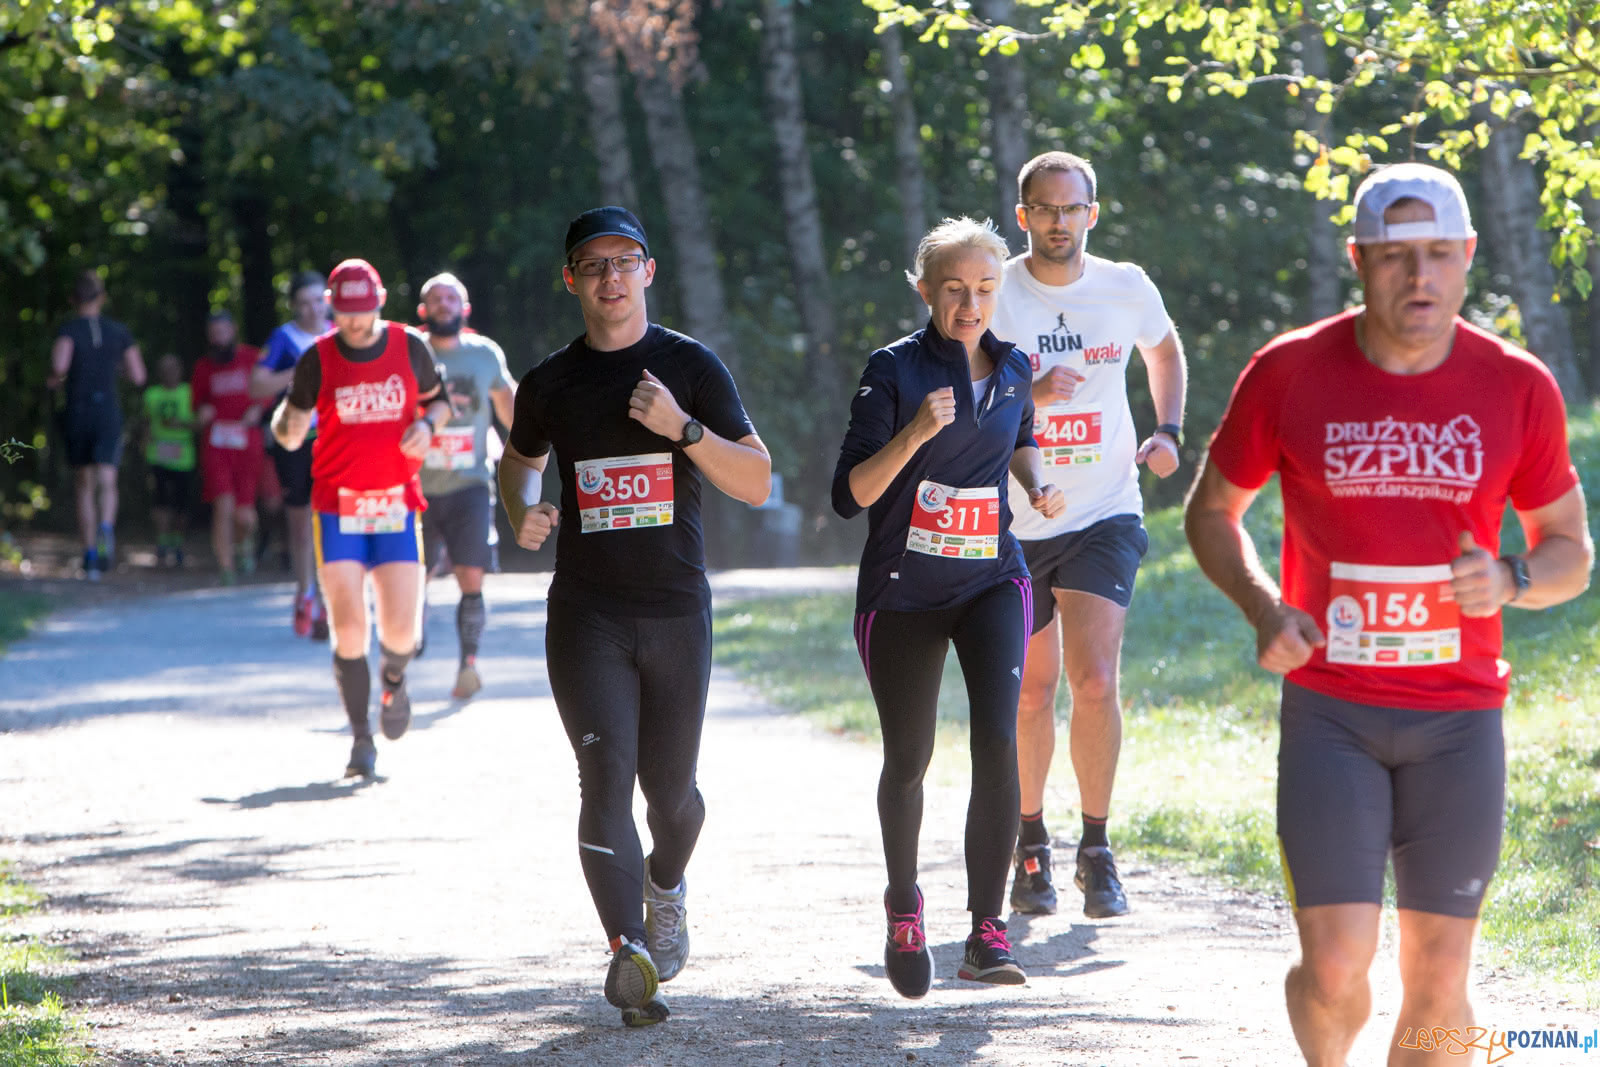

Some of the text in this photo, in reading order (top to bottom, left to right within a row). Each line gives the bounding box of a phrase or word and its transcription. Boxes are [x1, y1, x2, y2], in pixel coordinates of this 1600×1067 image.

[1038, 334, 1083, 353] RUN
[1044, 420, 1087, 443] 440
[1325, 416, 1456, 446] DRUŻYNA
[1324, 443, 1484, 481] SZPIKU
[600, 474, 649, 501] 350
[1330, 483, 1473, 504] www.darszpiku.pl
[936, 505, 980, 531] 311
[1363, 592, 1429, 627] 156
